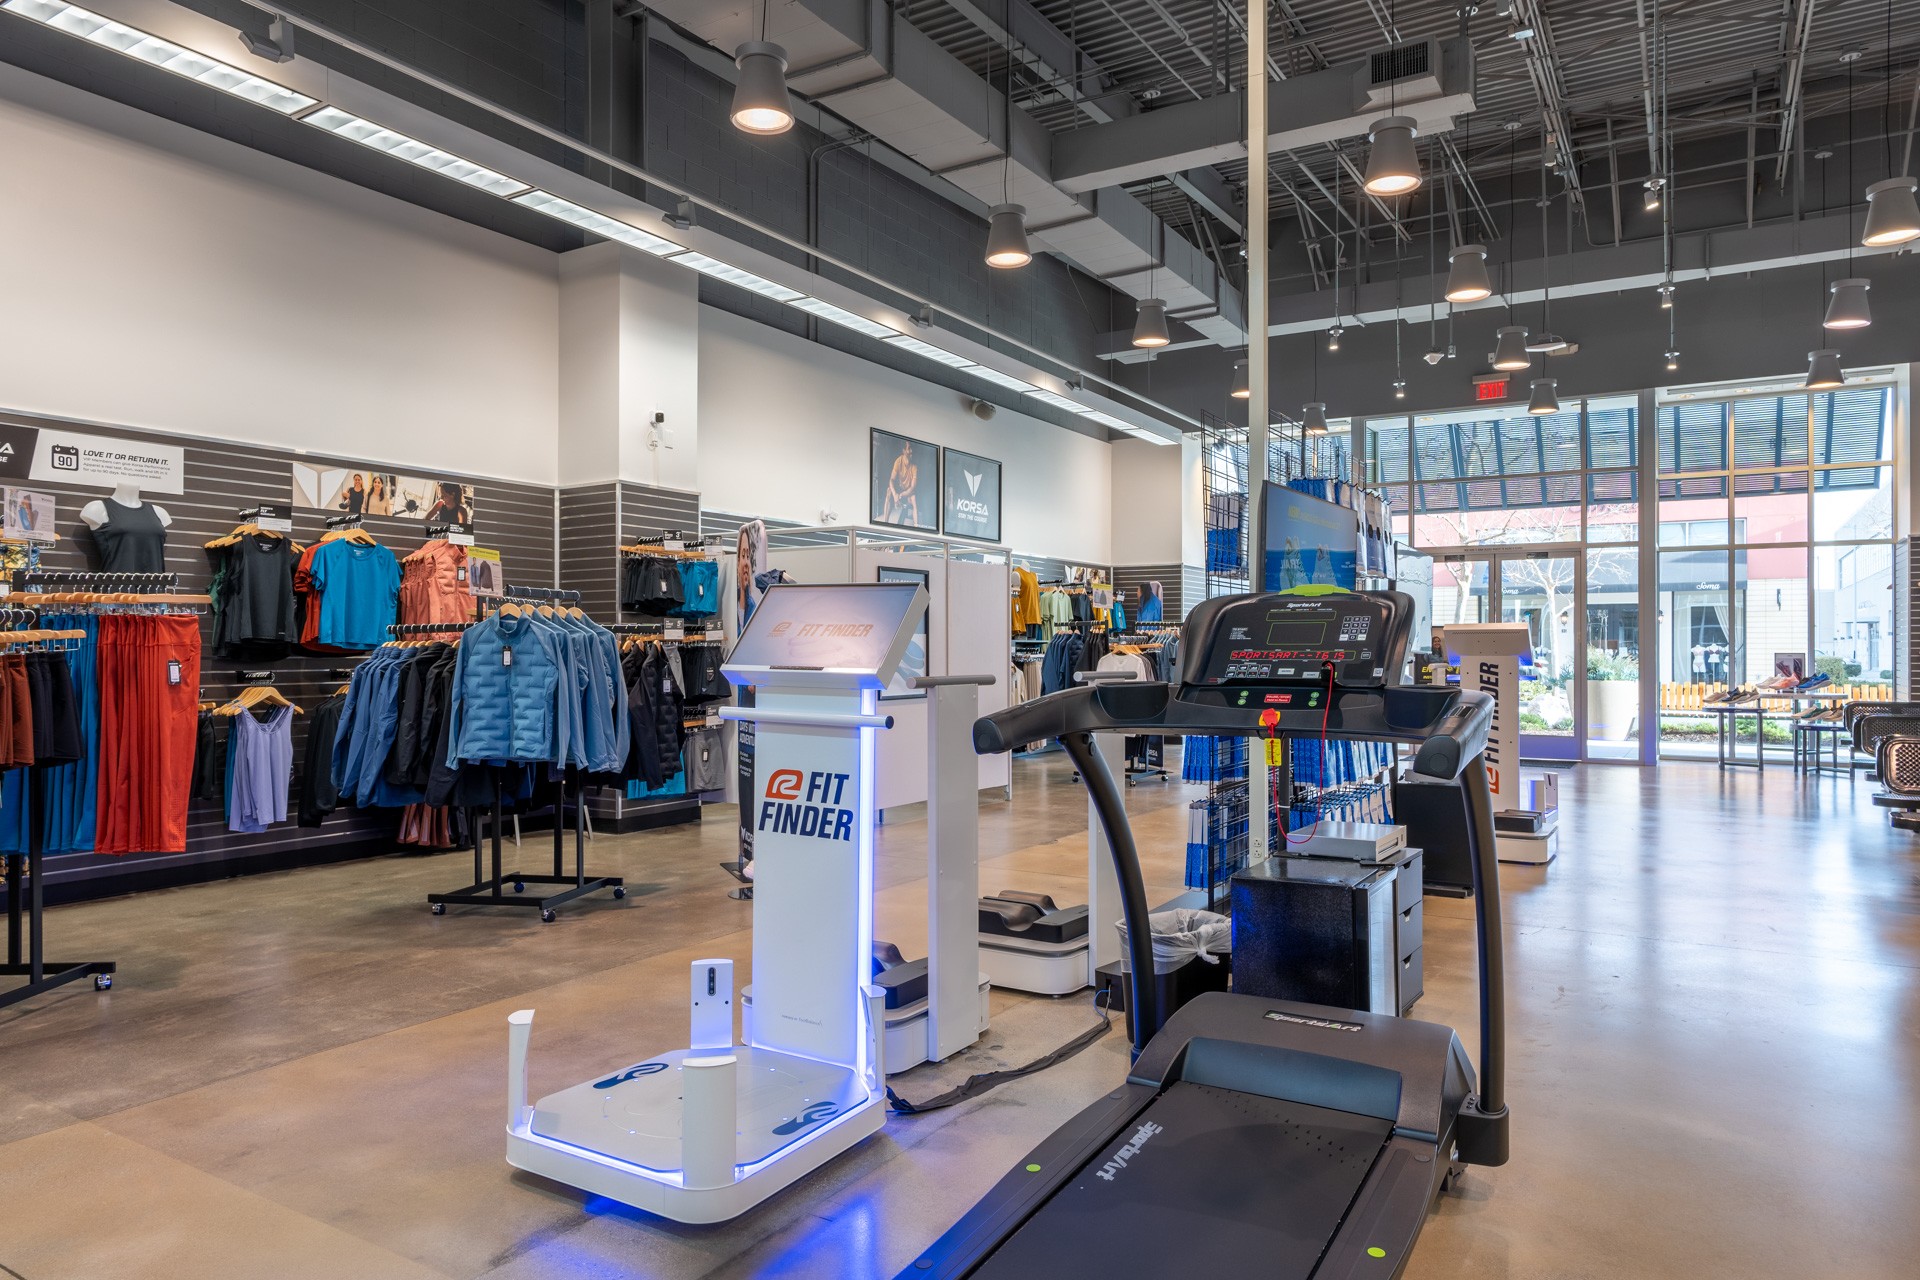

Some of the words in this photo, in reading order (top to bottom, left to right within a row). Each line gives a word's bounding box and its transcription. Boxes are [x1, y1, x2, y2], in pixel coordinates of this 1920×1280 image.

[1479, 382, 1505, 399] EXIT
[58, 456, 73, 467] 90
[83, 449, 104, 458] LOVE
[128, 455, 160, 464] RETURN
[957, 498, 988, 516] KORSA
[1696, 581, 1720, 590] Soma
[797, 623, 822, 637] FIT
[820, 624, 874, 638] FINDER
[806, 771, 850, 805] FIT
[758, 800, 854, 842] FINDER
[1264, 1012, 1362, 1032] SportsArt
